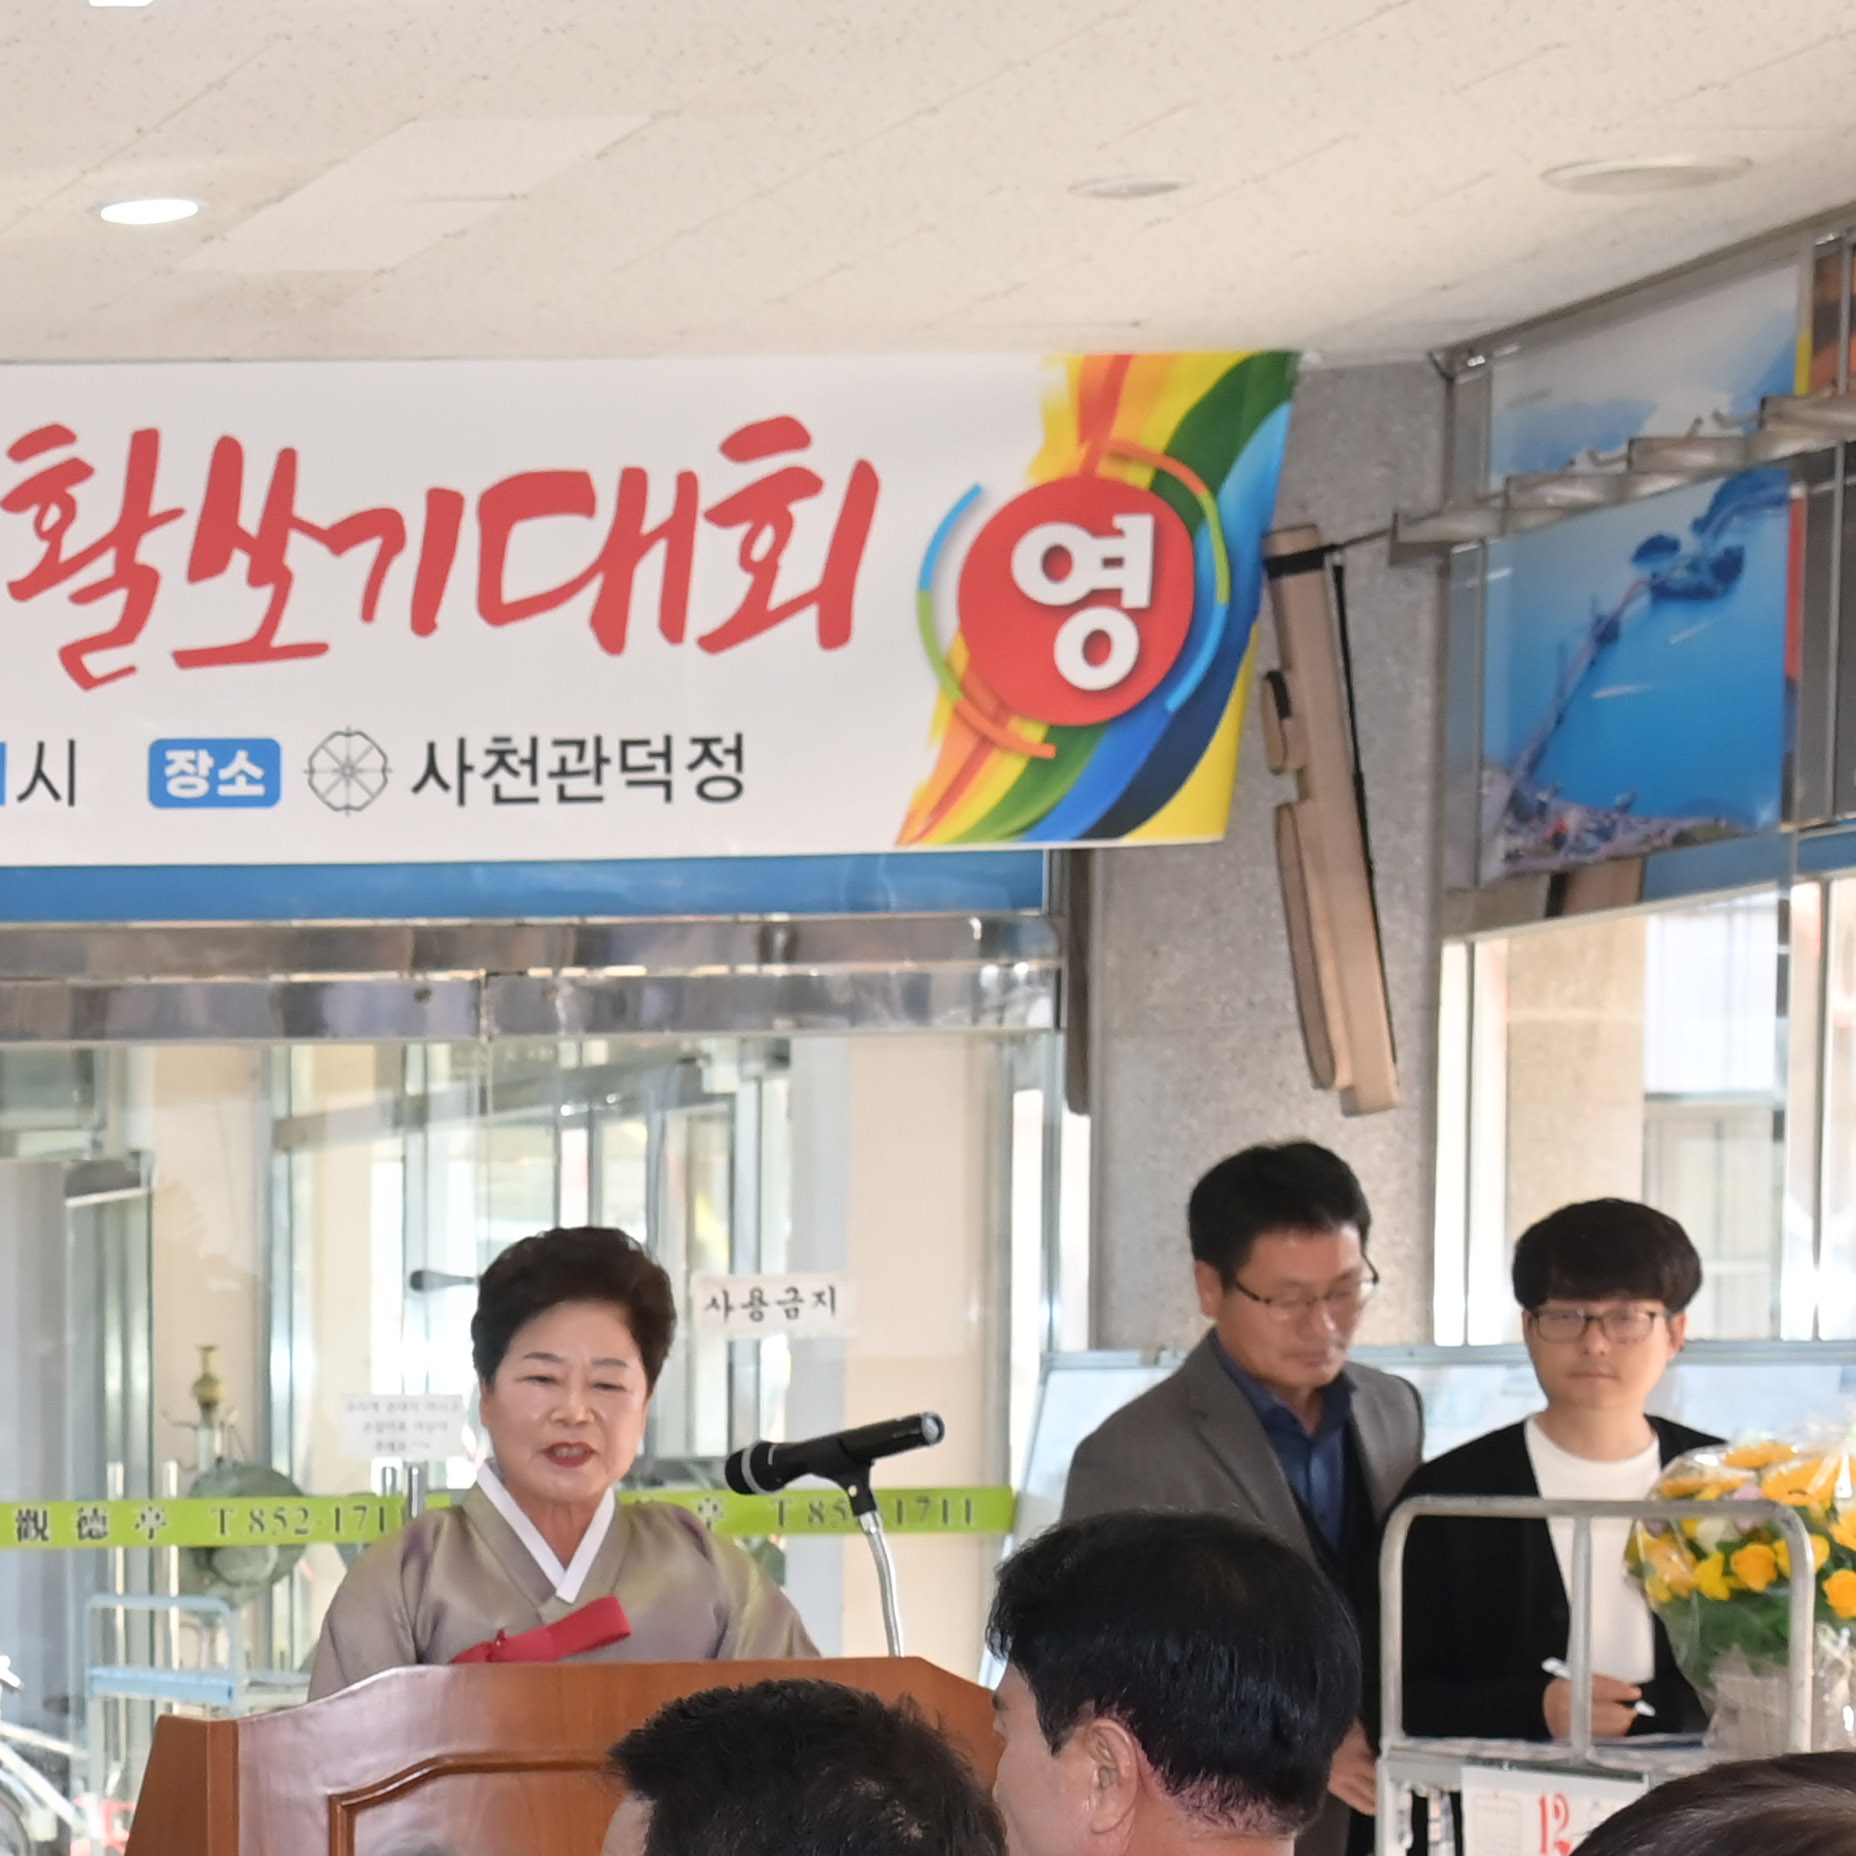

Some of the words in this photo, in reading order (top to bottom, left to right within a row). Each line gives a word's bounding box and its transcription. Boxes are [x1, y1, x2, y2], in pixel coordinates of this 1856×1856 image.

[1010, 512, 1157, 692] 영
[164, 745, 268, 803] 장소
[409, 732, 748, 808] 사천관덕정
[704, 1284, 837, 1324] 사용금지
[1540, 1792, 1572, 1856] 12
